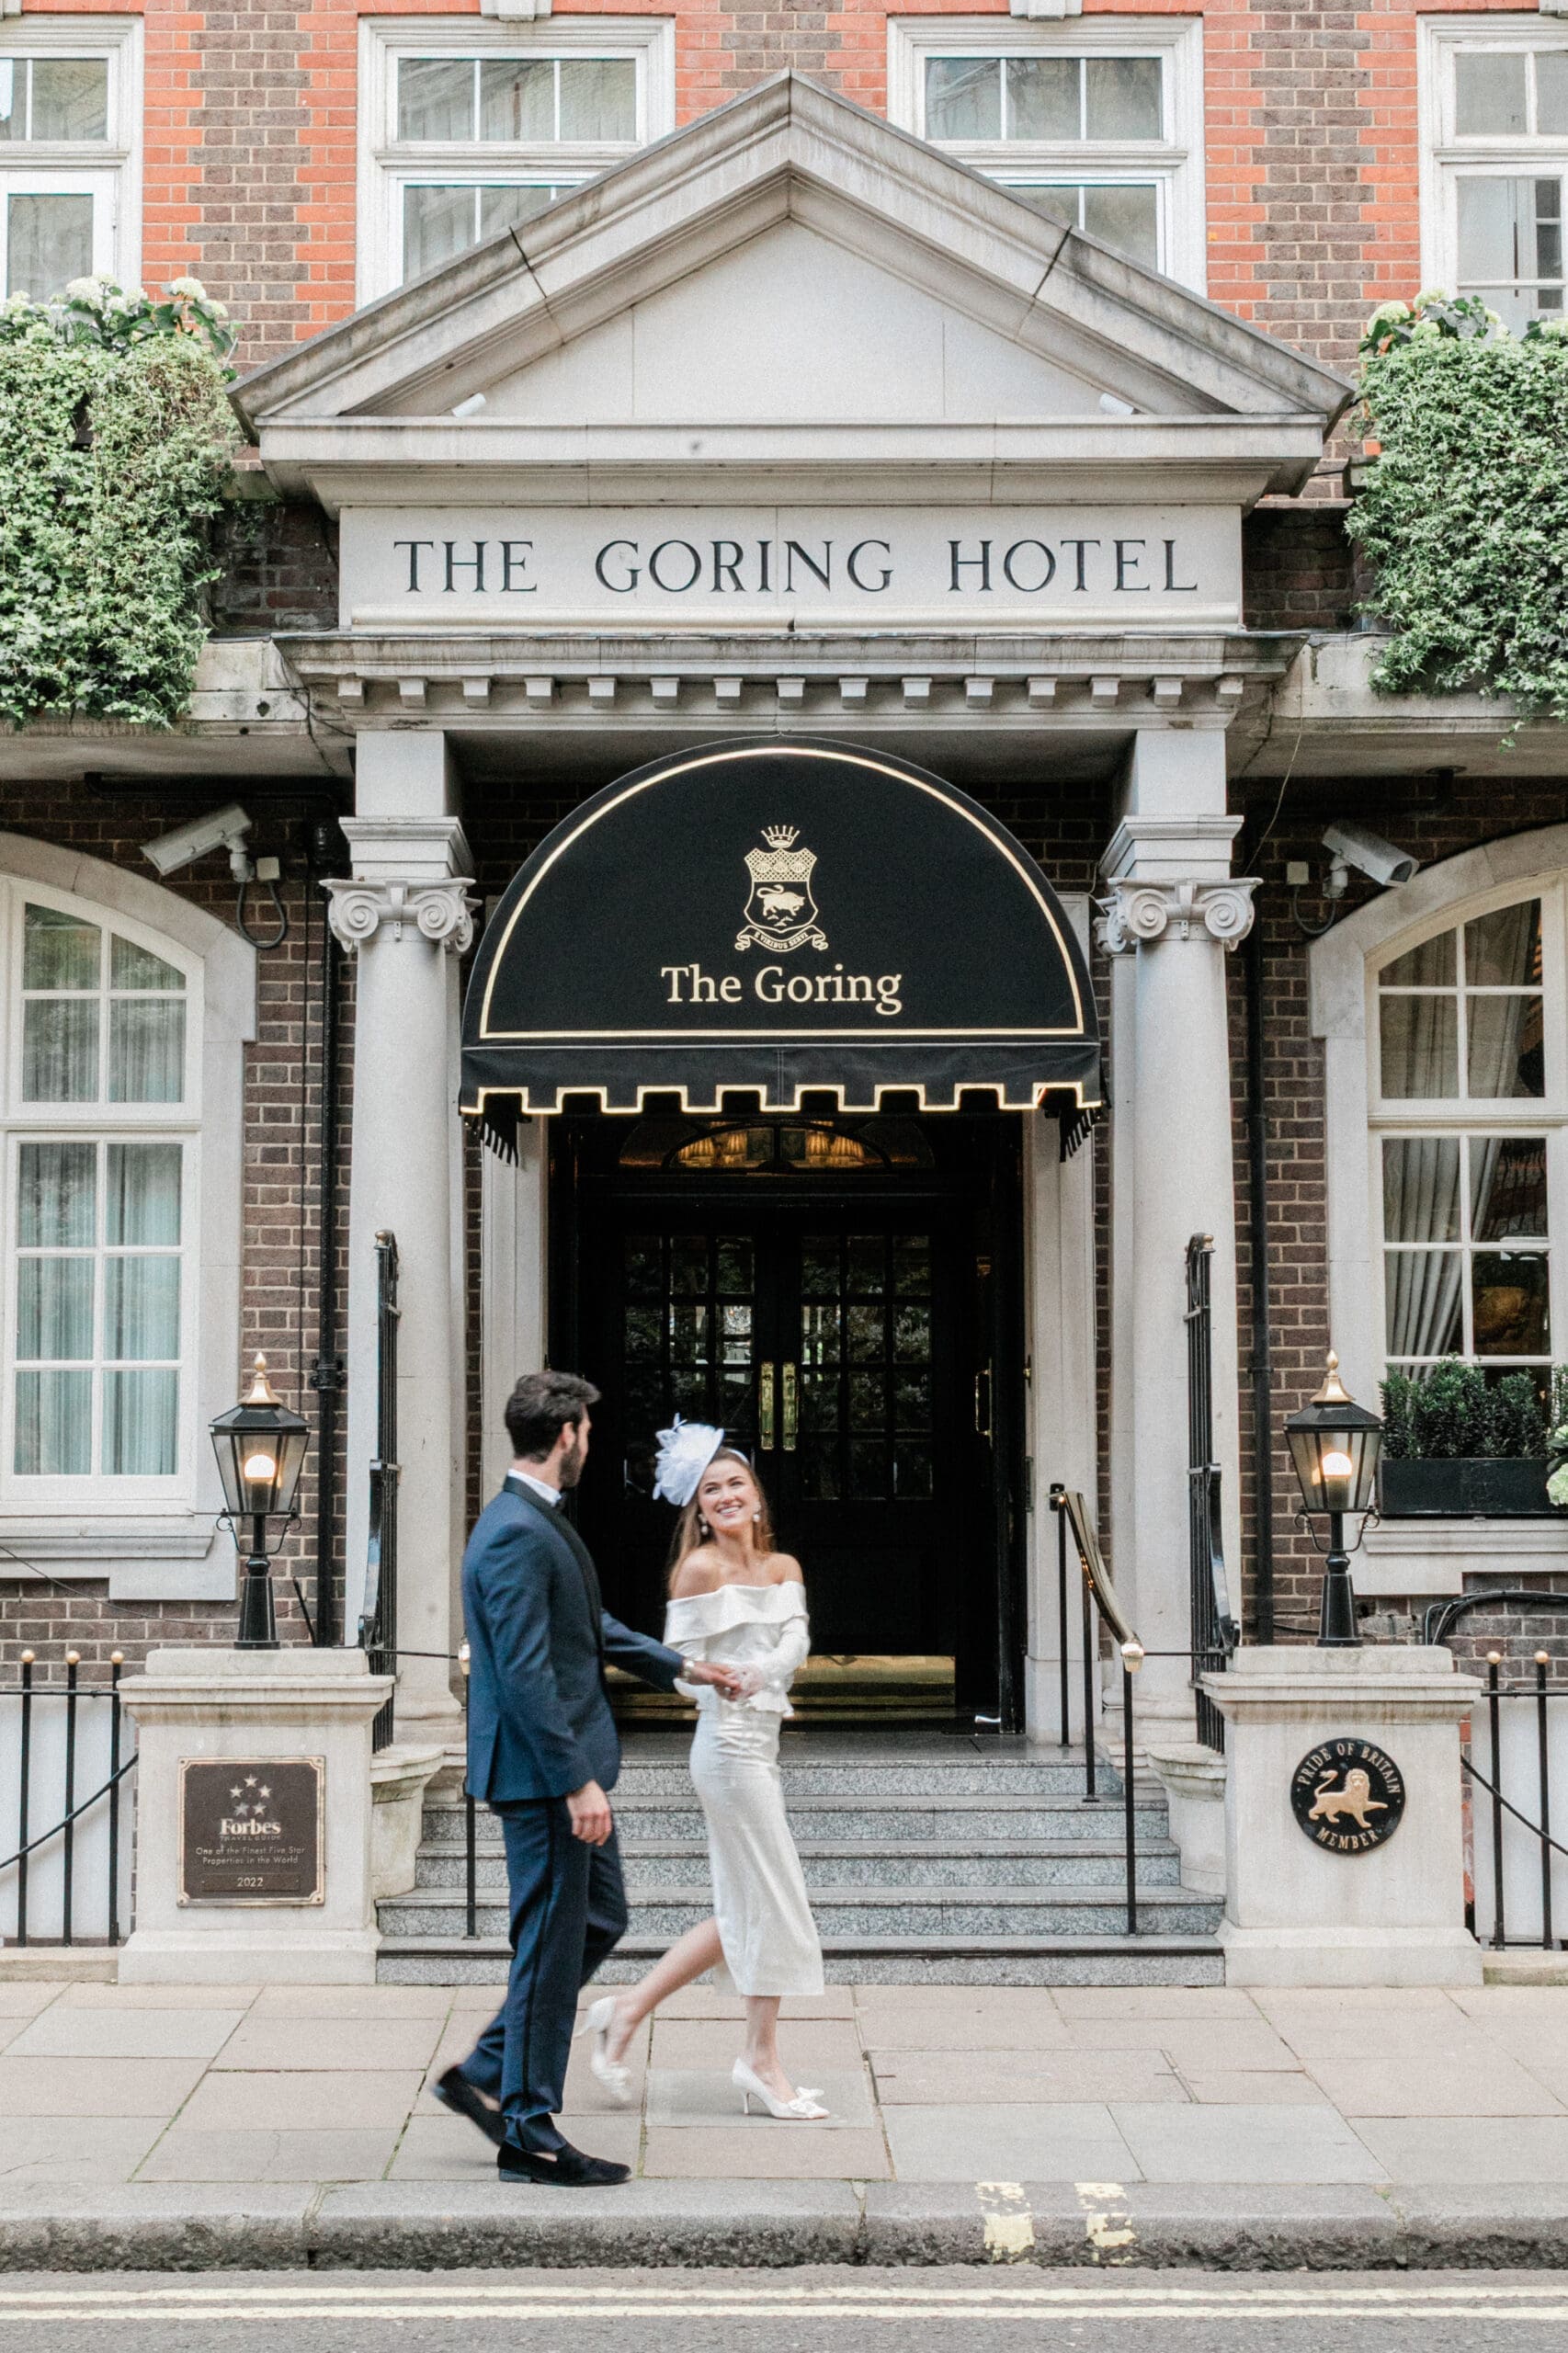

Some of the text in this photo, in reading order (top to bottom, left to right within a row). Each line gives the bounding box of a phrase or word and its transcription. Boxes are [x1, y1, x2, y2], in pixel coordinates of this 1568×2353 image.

[393, 539, 1199, 594] THE GORING HOTEL
[661, 963, 903, 1016] The Goring
[1297, 1743, 1401, 1794] PRIDE OF BRITAIN
[220, 1818, 281, 1835] Forbes
[1316, 1826, 1380, 1849] MEMBER
[196, 1846, 305, 1855] One of the Finest Five Star
[202, 1855, 299, 1866] Properties in the World
[236, 1877, 264, 1887] 2022
